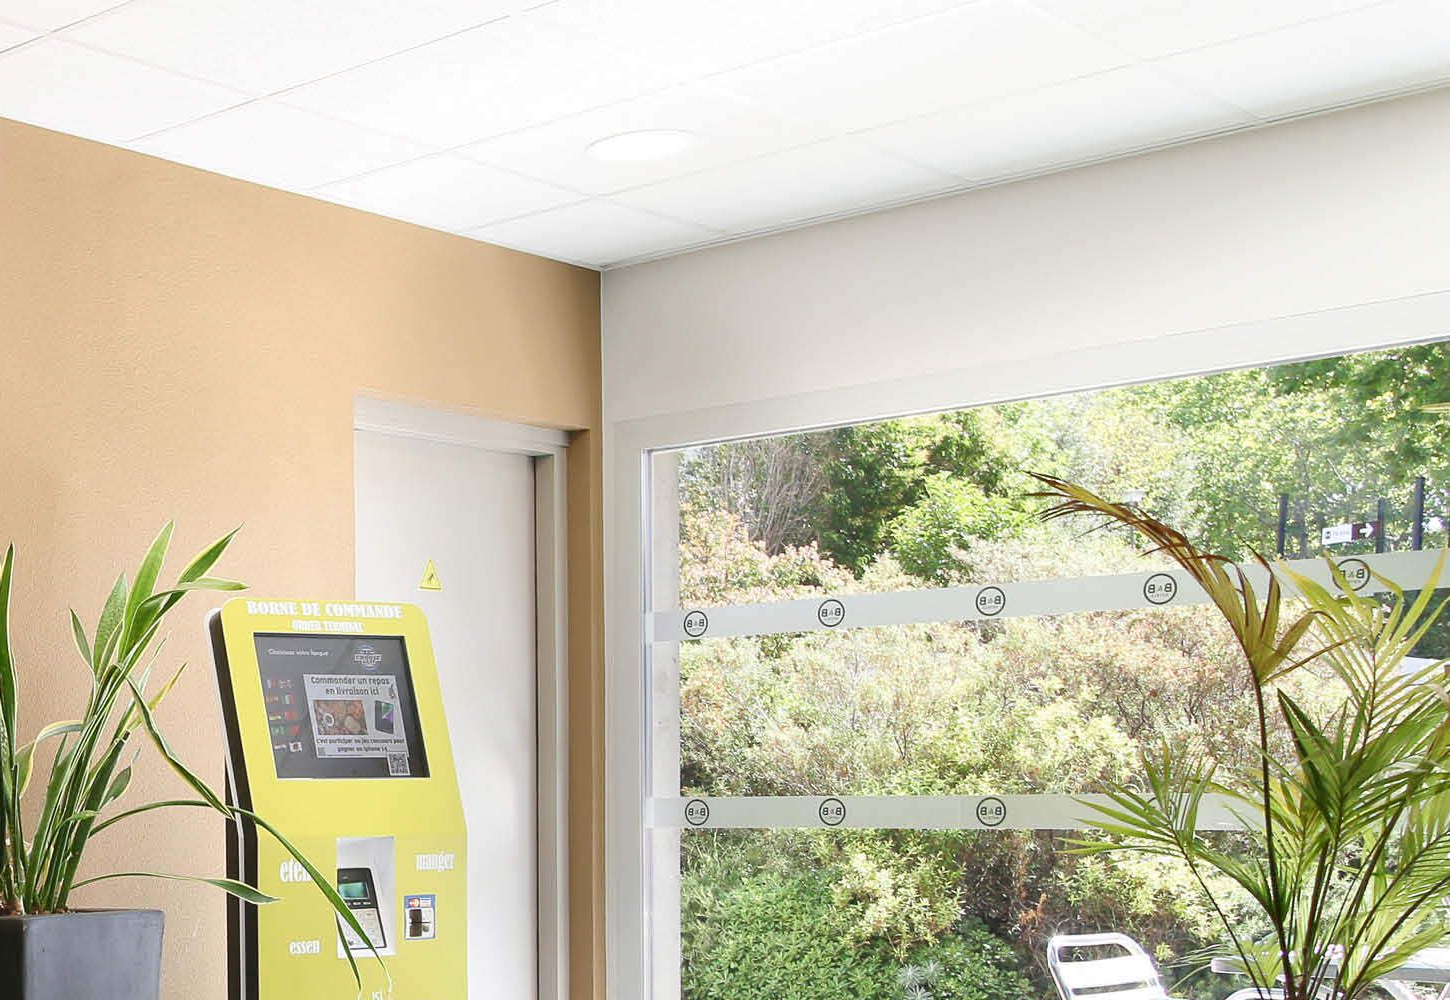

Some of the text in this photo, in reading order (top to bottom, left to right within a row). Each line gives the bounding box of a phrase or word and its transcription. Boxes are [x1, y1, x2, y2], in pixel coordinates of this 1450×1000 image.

[247, 601, 403, 618] BORNE DE COMMANDE
[311, 676, 390, 687] Commander un repas
[325, 687, 335, 695] en
[336, 687, 370, 696] livraison
[290, 940, 320, 954] essen
